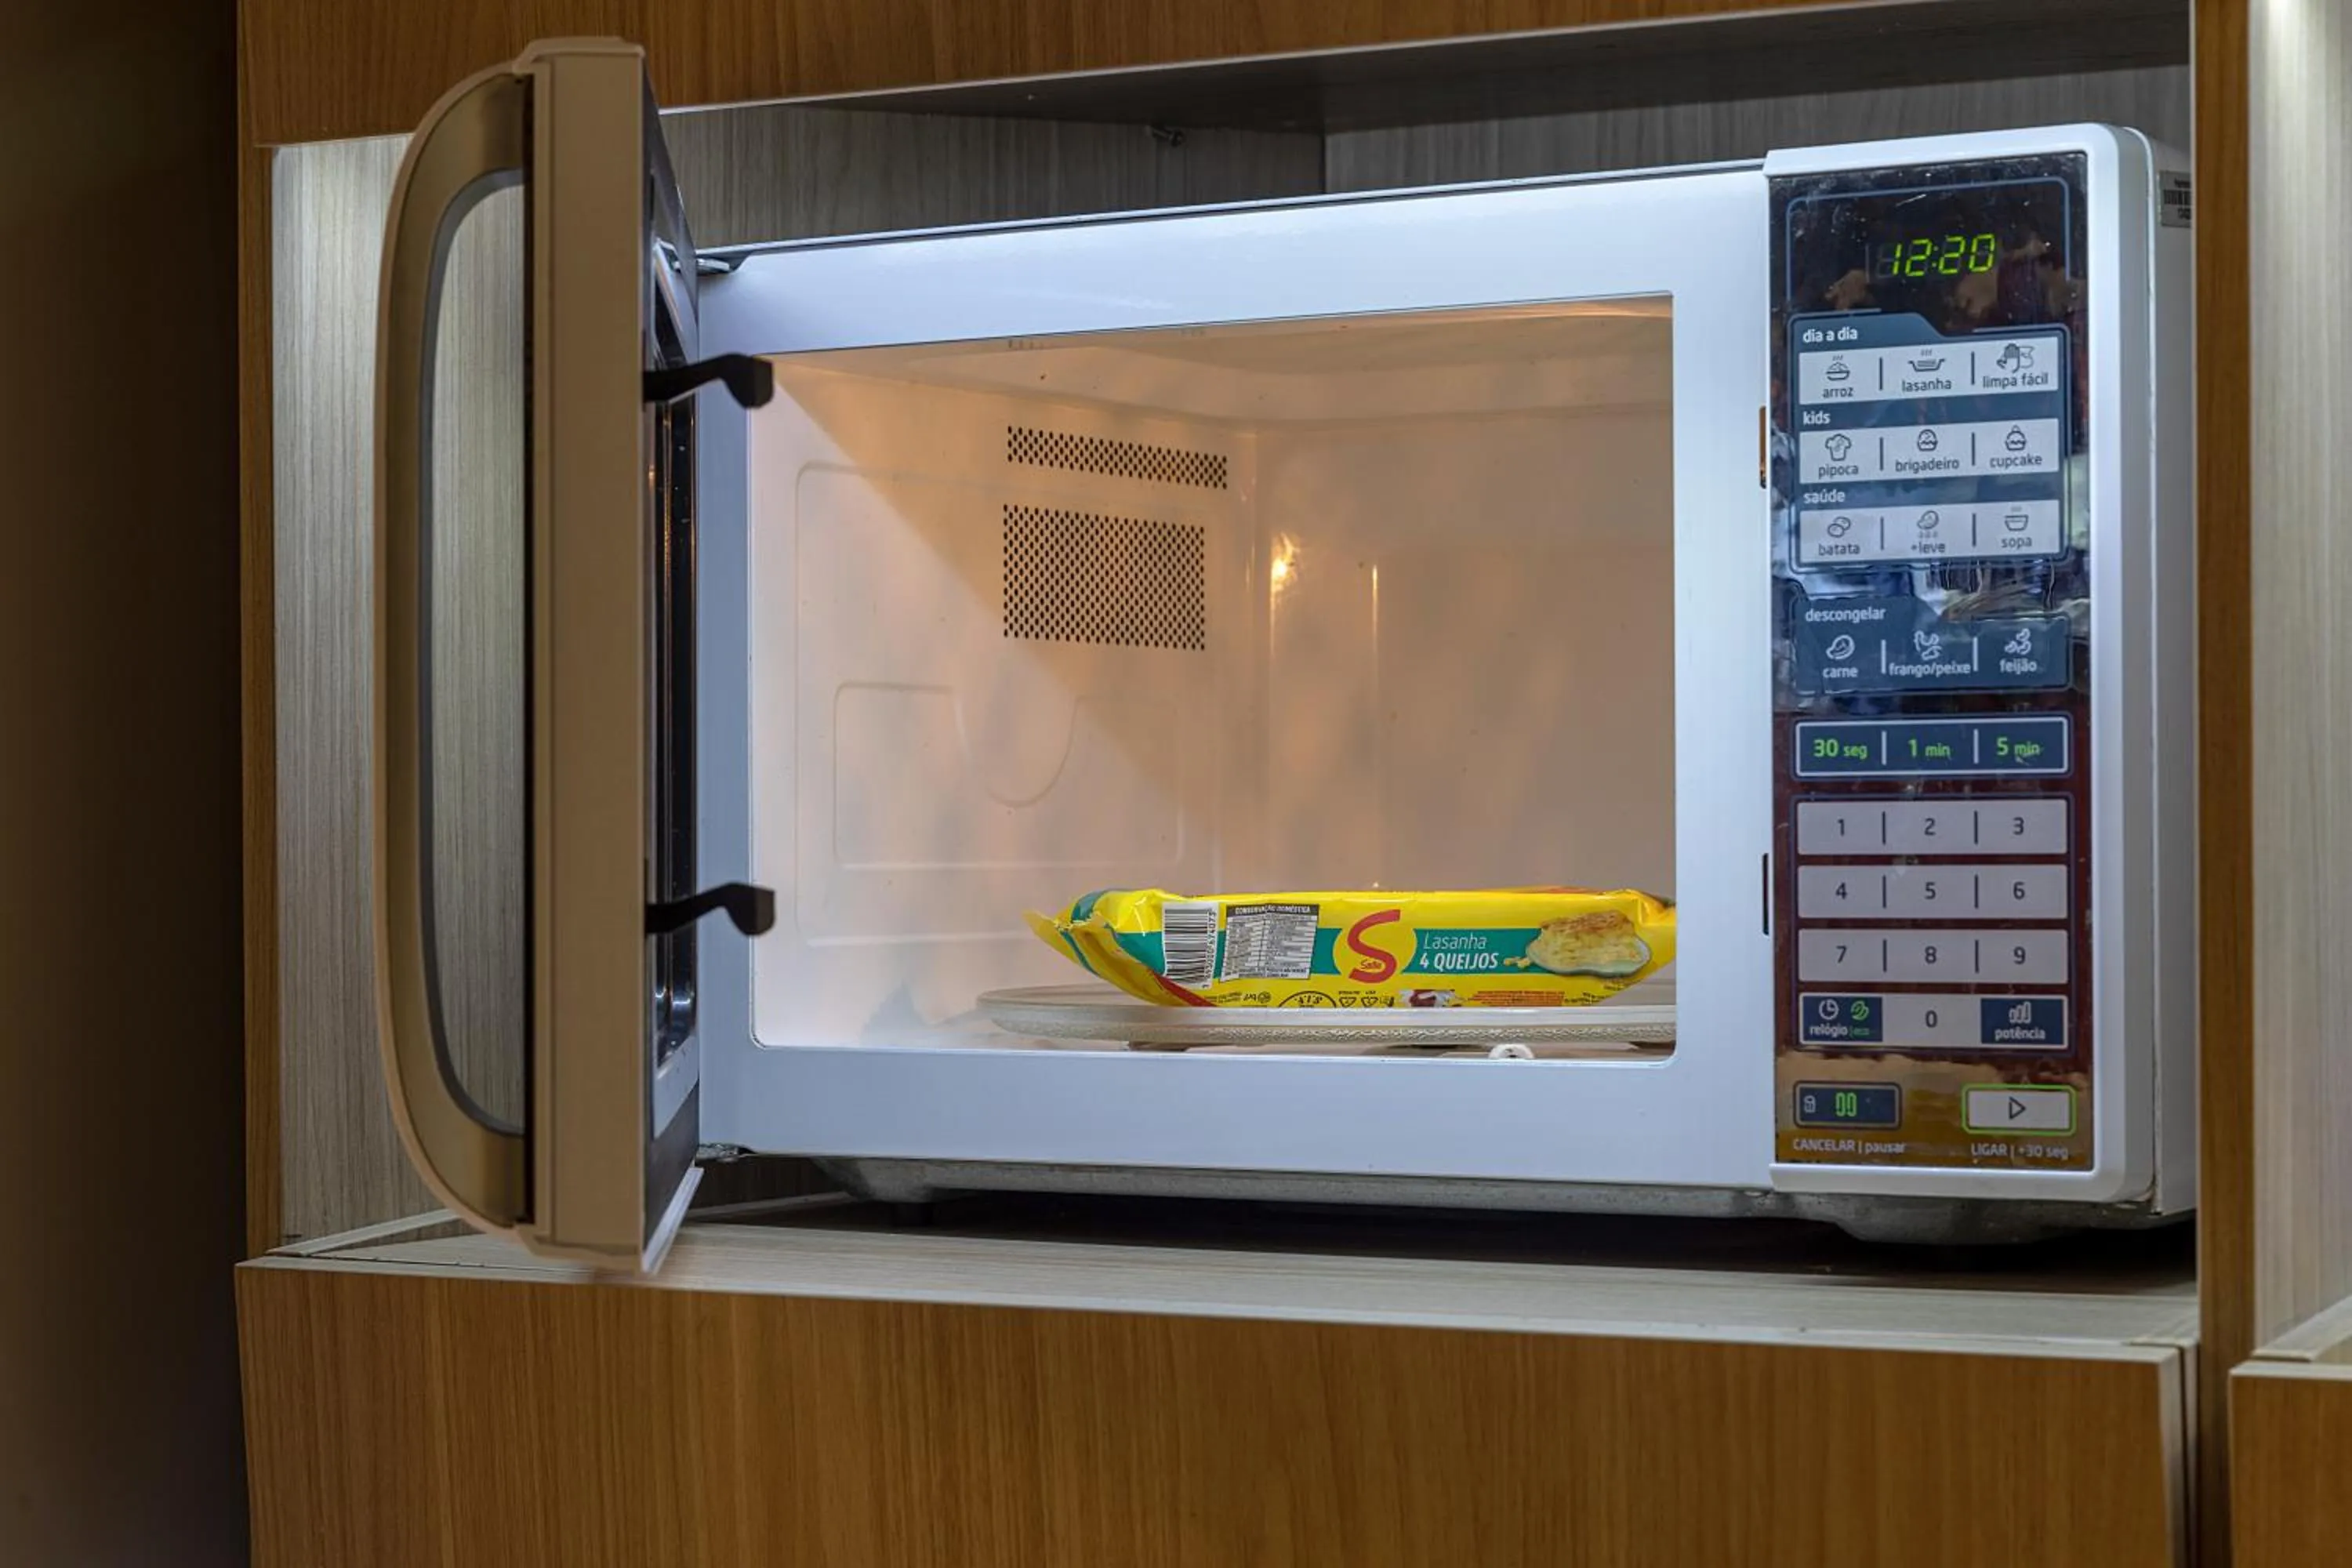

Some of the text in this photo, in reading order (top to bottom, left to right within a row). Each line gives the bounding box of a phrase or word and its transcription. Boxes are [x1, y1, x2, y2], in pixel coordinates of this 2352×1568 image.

[1890, 234, 1995, 277] 12:20
[1802, 326, 1858, 343] dia a dia
[1901, 378, 1952, 392] lasanha
[1982, 372, 2049, 390] limpa fácil
[1822, 386, 1854, 398] arroz
[1802, 410, 1831, 425] kids
[1895, 457, 1960, 474] brigadeiro
[1989, 453, 2042, 470] cupcake
[1818, 463, 1859, 479] pipoca
[1803, 489, 1846, 504] saúde
[1818, 542, 1860, 556] batata
[2001, 536, 2032, 550] sopa
[1805, 607, 1886, 624] descongelar
[1823, 666, 1858, 678] carne
[1889, 661, 1972, 678] frango/peixe
[1999, 657, 2038, 673] feijão
[1813, 739, 1868, 760] 30 seg
[1907, 739, 1951, 757] 1 min
[1996, 737, 2040, 756] 5 min
[1837, 818, 1845, 837] 1
[1924, 818, 1936, 836] 2
[2013, 817, 2024, 835] 3
[1835, 882, 1847, 899] 4
[1925, 882, 1936, 899] 5
[2013, 882, 2025, 899] 6
[1424, 931, 1487, 949] Lasanha
[1419, 953, 1499, 972] 4 QUEIJOS
[1836, 946, 1847, 963] 7
[1925, 946, 1937, 964] 8
[2014, 946, 2026, 964] 9
[1926, 1011, 1937, 1028] 0
[1809, 1022, 1848, 1038] relógio
[1994, 1026, 2045, 1041] potência
[1793, 1139, 1907, 1154] CANCELAR pausar
[1972, 1143, 2008, 1156] LIGAR
[2046, 1146, 2069, 1160] seg
